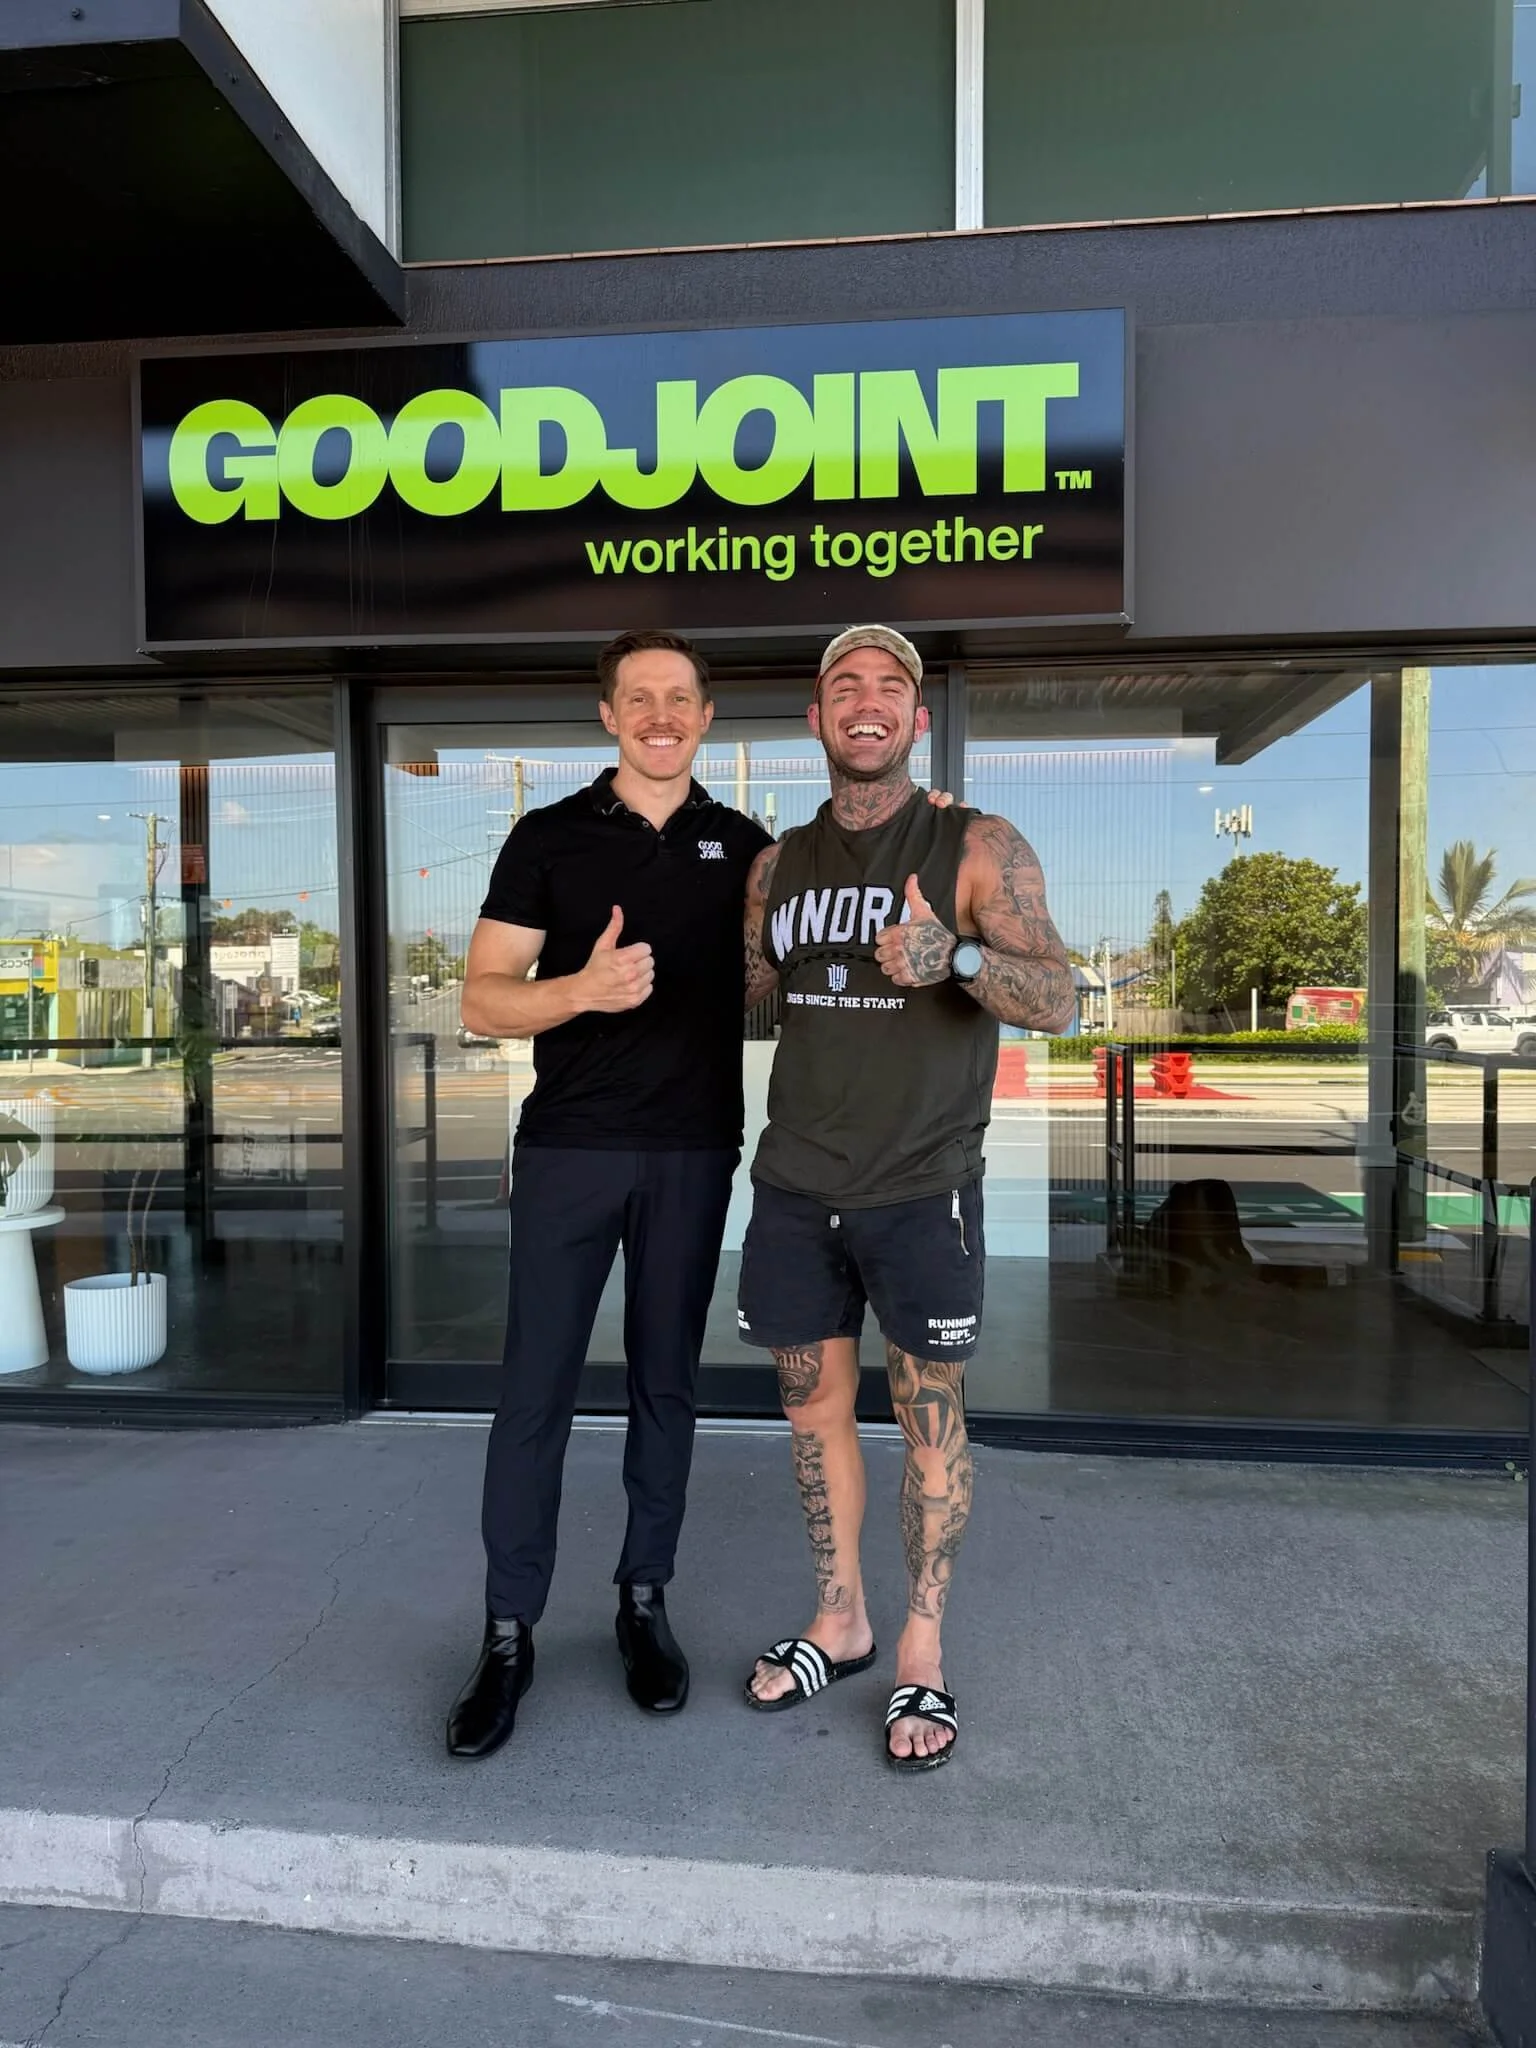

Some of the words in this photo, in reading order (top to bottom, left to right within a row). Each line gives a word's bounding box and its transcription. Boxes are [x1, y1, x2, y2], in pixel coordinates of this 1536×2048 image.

[585, 526, 796, 581] working
[810, 516, 1044, 577] together
[698, 840, 722, 850] GOOD
[771, 886, 931, 963] WNDR
[804, 994, 836, 1007] SINCE
[838, 996, 861, 1008] THE
[863, 998, 905, 1009] START
[928, 1315, 977, 1329] RUNNING
[941, 1328, 970, 1340] DEPT.
[918, 1701, 947, 1711] adidas
